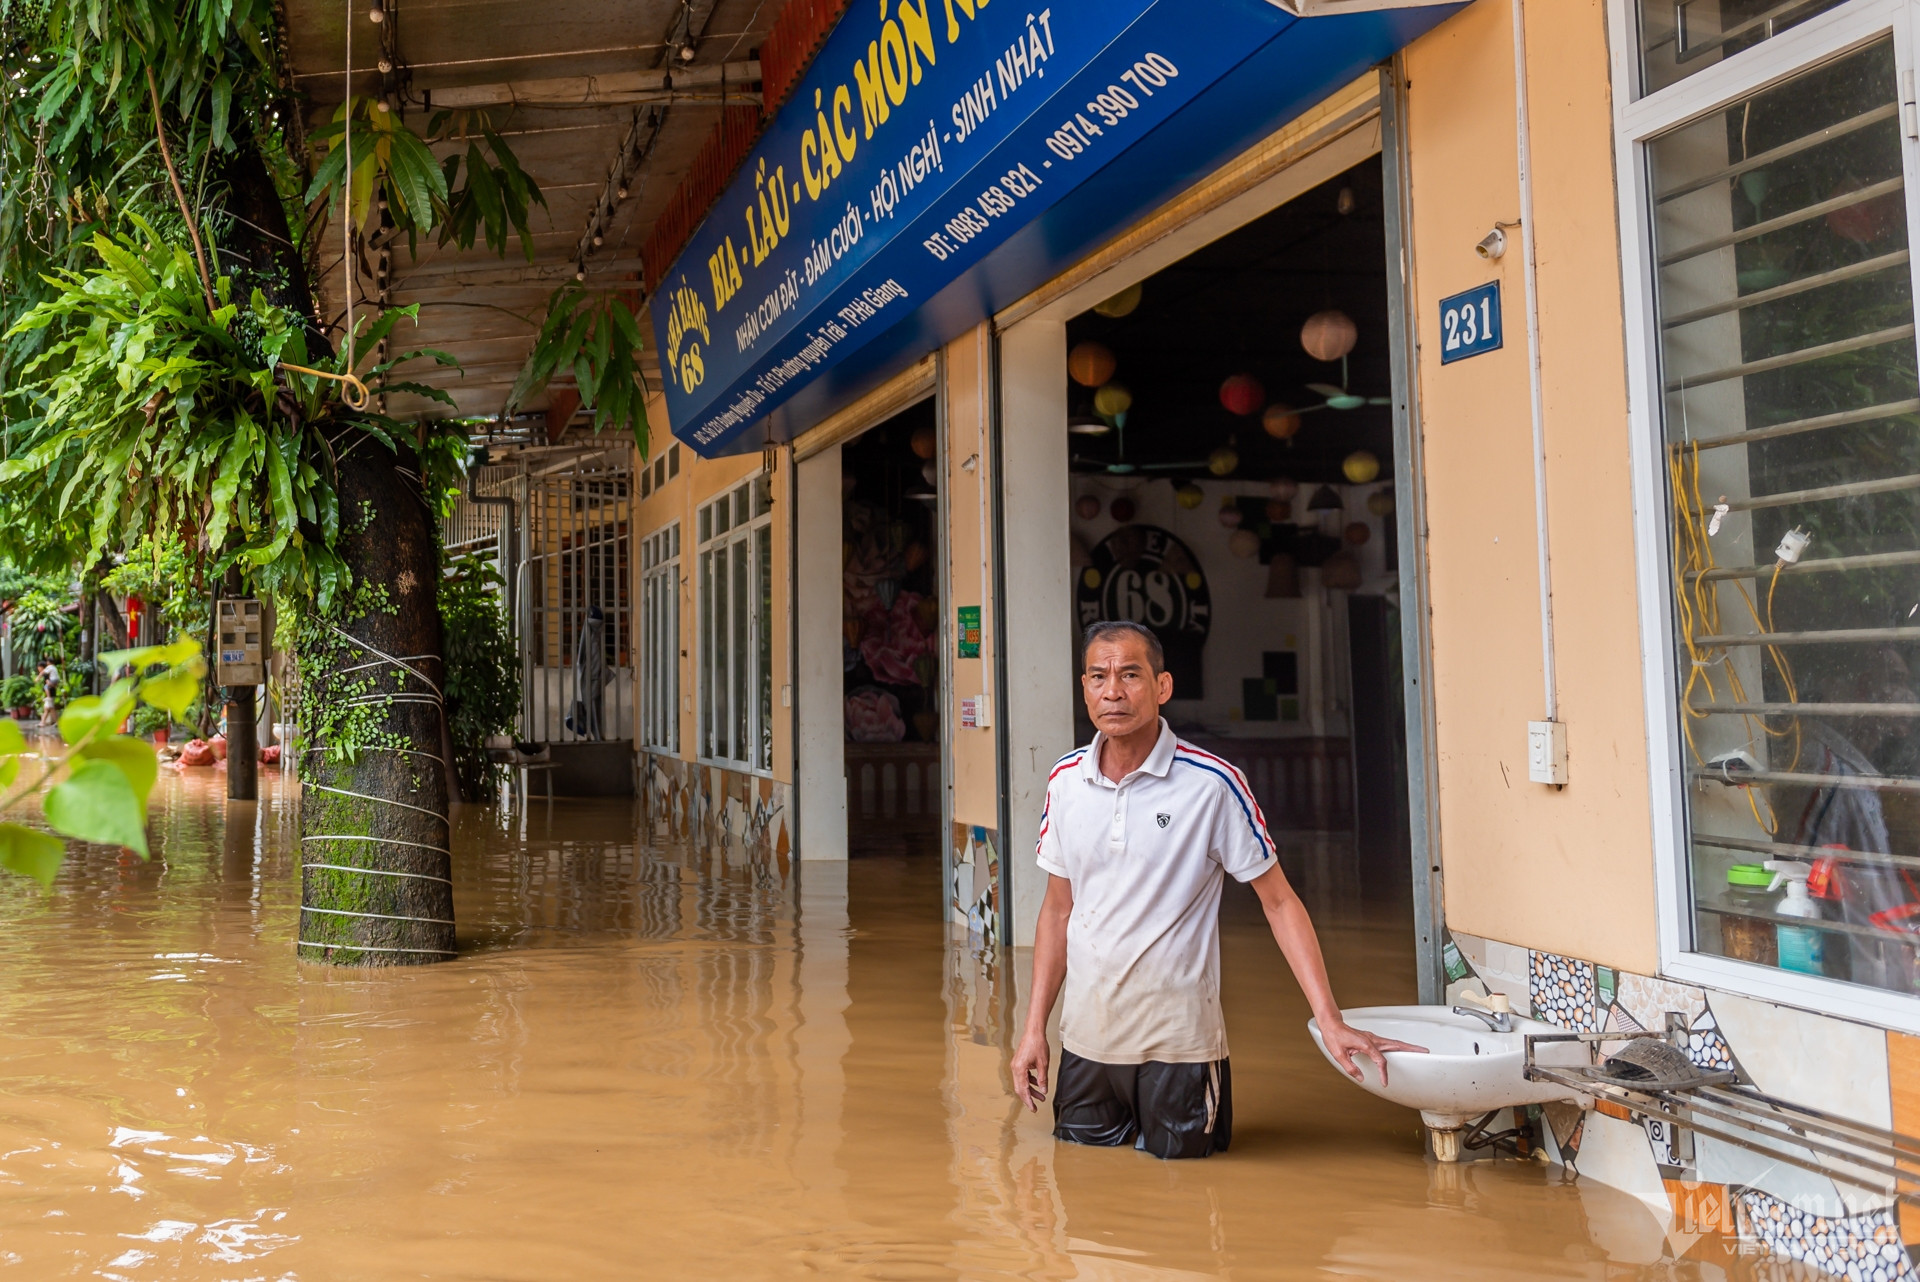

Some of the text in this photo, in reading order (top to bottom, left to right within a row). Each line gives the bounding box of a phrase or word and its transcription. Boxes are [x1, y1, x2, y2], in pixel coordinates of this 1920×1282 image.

[708, 236, 743, 311] BIA
[745, 157, 789, 267] LẨU
[801, 84, 857, 201] CÁC
[854, 0, 936, 140] MÓN
[736, 312, 760, 353] NHẬN
[758, 289, 781, 331] CƠM
[779, 268, 799, 311] ĐẶT
[804, 238, 831, 286] ĐÁM
[831, 201, 863, 259] CƯỚI
[870, 168, 900, 222] HỘI
[898, 119, 944, 196] NGHỊ
[952, 70, 997, 143] SINH
[996, 8, 1055, 100] NHẬT
[923, 232, 960, 261] ĐT:
[945, 207, 990, 244] 0983
[977, 185, 1016, 218] 458
[1000, 162, 1043, 198] 821
[1046, 113, 1104, 161] 0974
[1087, 85, 1139, 126] 390
[1120, 52, 1179, 97] 700
[862, 278, 909, 308] Giang
[667, 274, 711, 384] NHÀ HÀNG
[818, 320, 848, 343] Trãi
[1444, 297, 1493, 351] 231
[681, 342, 705, 394] 68
[756, 374, 777, 393] Tổ
[765, 371, 785, 387] 13
[770, 356, 812, 382] Phường
[745, 389, 766, 403] Du
[1116, 569, 1174, 627] 68
